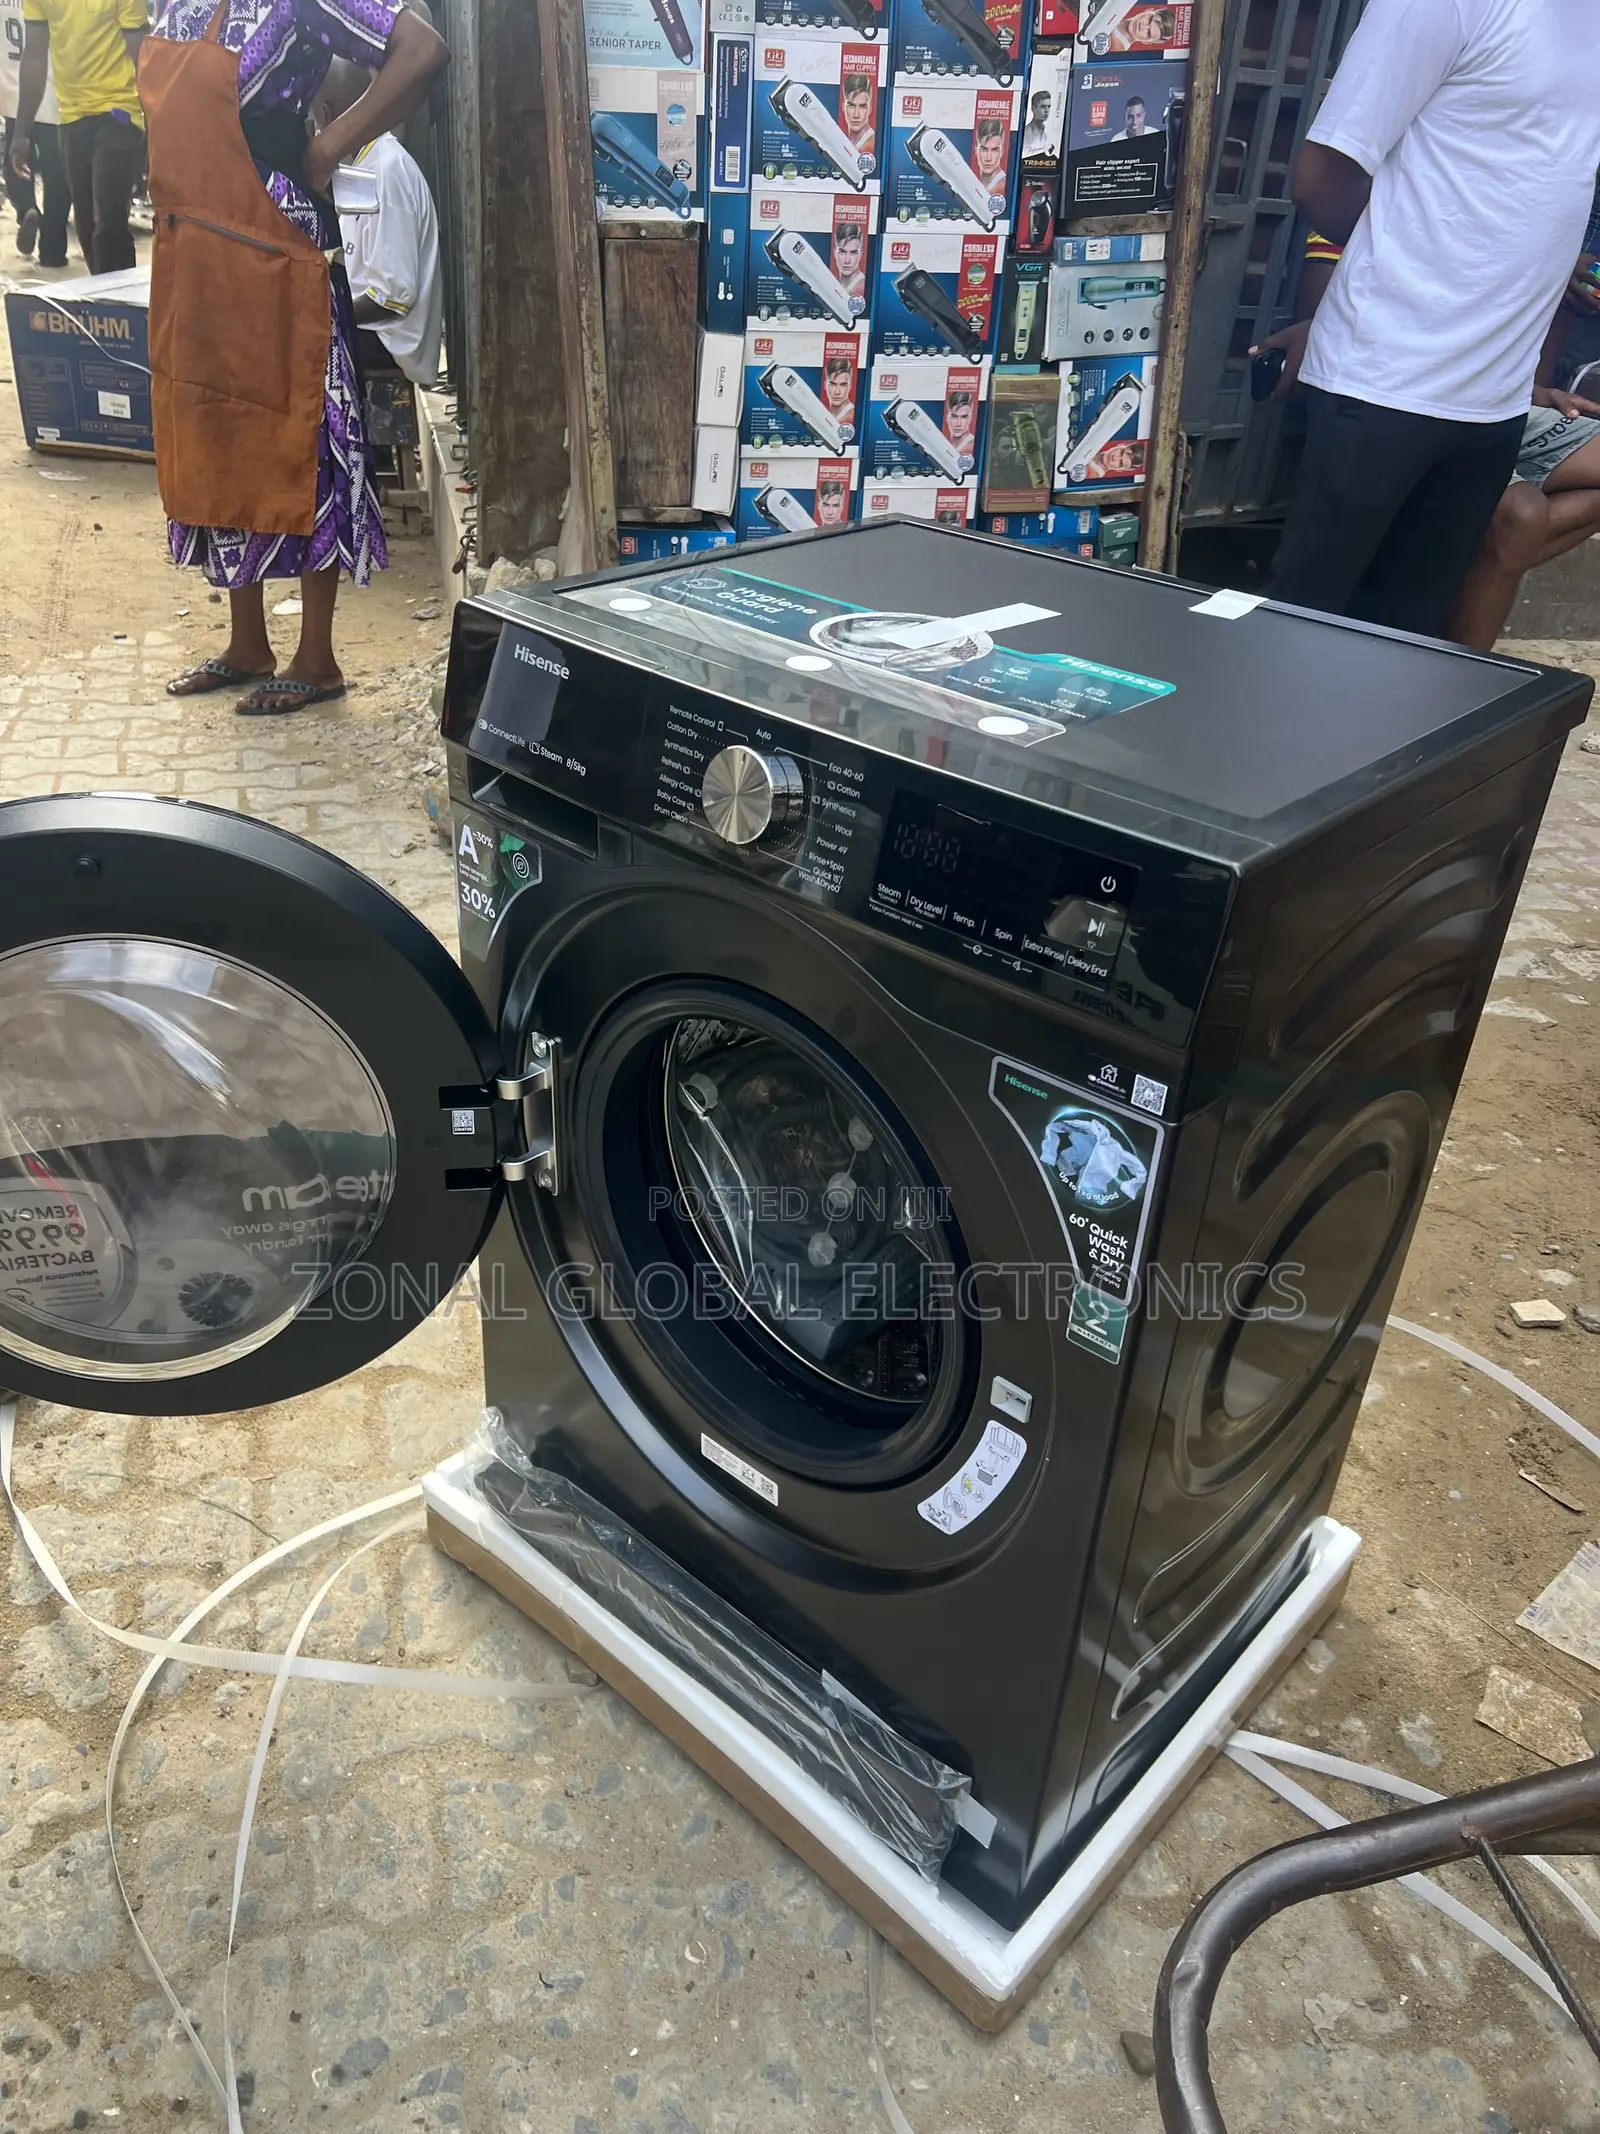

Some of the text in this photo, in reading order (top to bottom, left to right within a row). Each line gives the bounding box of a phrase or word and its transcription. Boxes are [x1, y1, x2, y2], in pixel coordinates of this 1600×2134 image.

[589, 37, 661, 50] SENIOR TAPER
[843, 54, 877, 64] RECHARGEABLE
[978, 100, 1010, 109] RECHARGEABLE
[1023, 159, 1057, 167] TRIMMER
[835, 204, 867, 214] RECHARGEABLE
[964, 244, 995, 253] CORDLESS
[1016, 263, 1043, 272] VGR
[716, 591, 785, 614] Guard
[733, 587, 818, 615] Hygiene
[724, 605, 754, 617] Made
[754, 614, 780, 624] Easy
[514, 643, 570, 679] Hisense
[1058, 656, 1166, 690] Hisense
[670, 705, 715, 728] Remote Control
[488, 723, 526, 747] ConnectLife
[667, 721, 699, 740] Cotton Dry
[756, 728, 771, 740] Auto
[664, 739, 705, 762] Synthetics Dry
[540, 746, 587, 776] Steam 8/5kg
[661, 756, 682, 770] Refresh
[829, 762, 864, 782] Eco 40-60
[659, 773, 693, 793] Allergy Care
[837, 785, 861, 799] Cotton
[656, 789, 686, 808] Baby Care
[821, 798, 856, 818] Synthetics
[653, 803, 689, 824] Drum Clean
[834, 823, 853, 837] Wool
[458, 824, 494, 865] A -30%
[816, 836, 838, 851] Power
[813, 866, 832, 880] Quick
[461, 881, 496, 919] 30%
[877, 883, 1108, 977] Steam Dry Level Temp. Spin Extra Rinse Delay End
[1004, 1074, 1048, 1099] Hisense
[1059, 1172, 1070, 1184] Up
[1067, 1181, 1077, 1191] to
[1069, 1213, 1129, 1249] 60' Quick
[1088, 1234, 1125, 1260] Wash
[1089, 1249, 1124, 1273] & Dry
[1085, 1300, 1110, 1336] 2
[1076, 1327, 1113, 1348] WARRANTY
